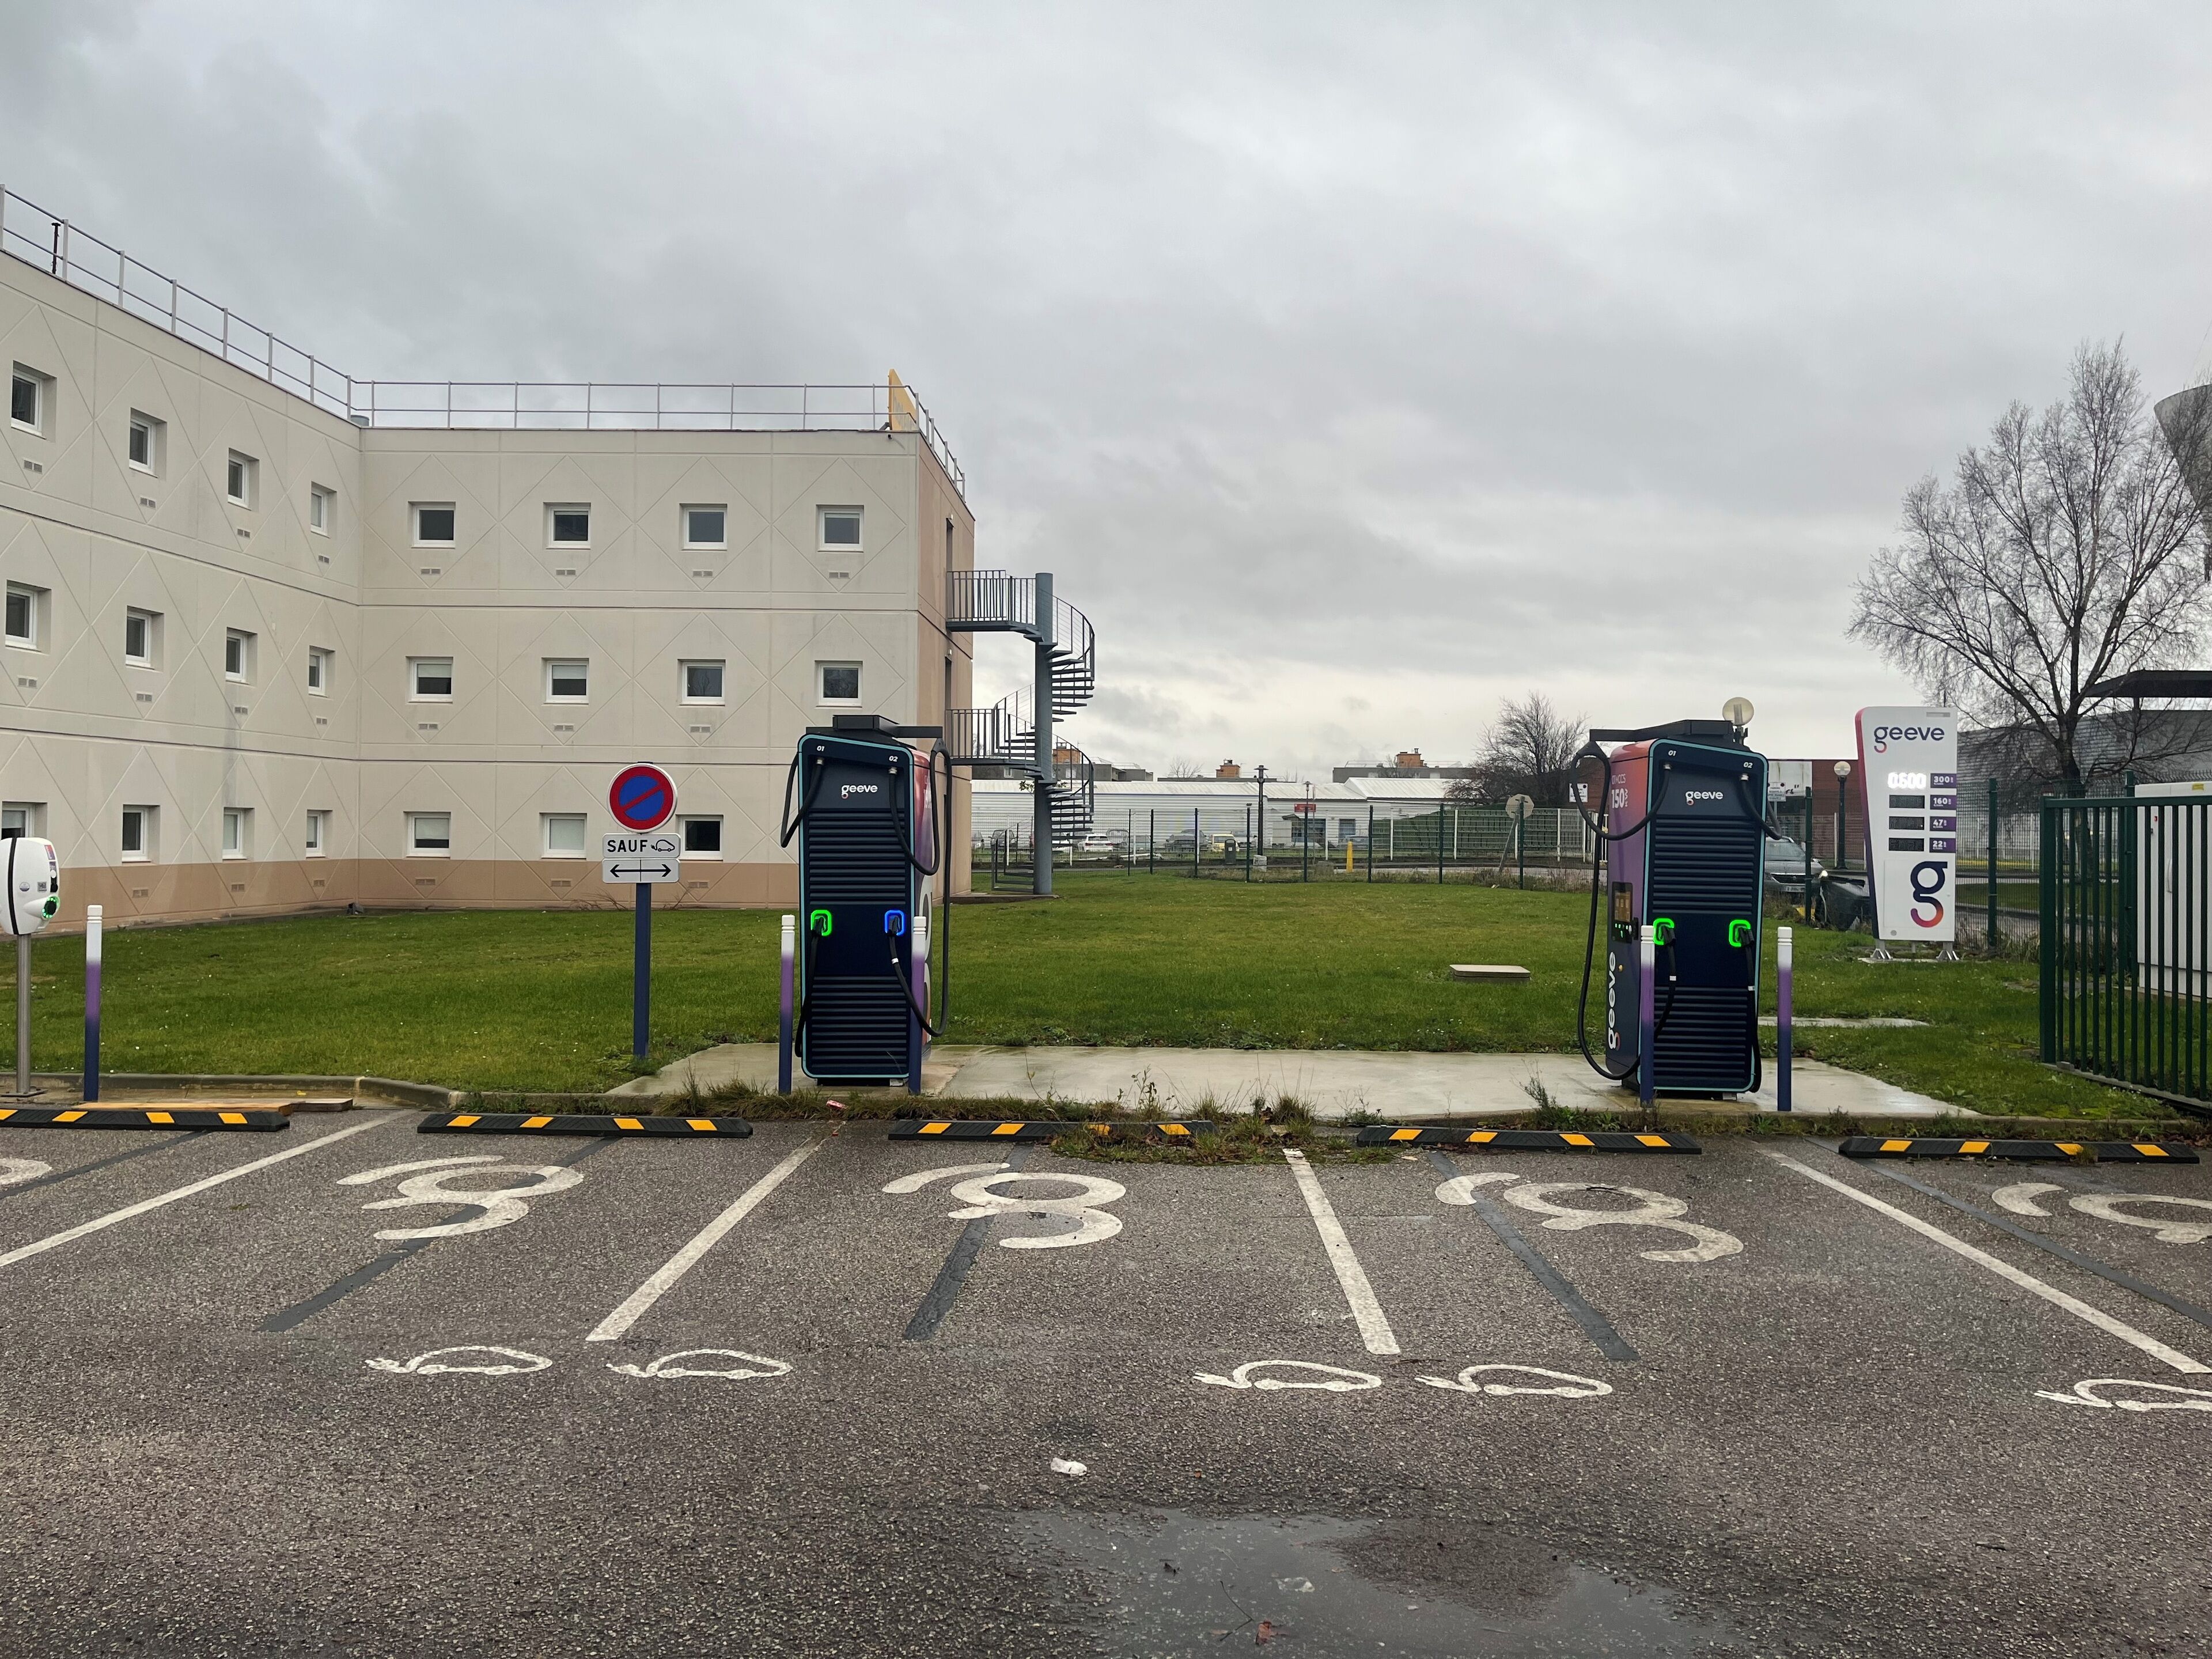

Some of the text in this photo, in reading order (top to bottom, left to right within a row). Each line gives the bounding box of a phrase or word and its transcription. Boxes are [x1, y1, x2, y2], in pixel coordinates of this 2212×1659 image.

[1874, 726, 1944, 753] geeve
[841, 785, 878, 800] geeve
[1612, 788, 1624, 808] 150
[1685, 791, 1724, 805] geeve
[607, 839, 648, 853] SAUF
[1608, 952, 1620, 1051] geeve
